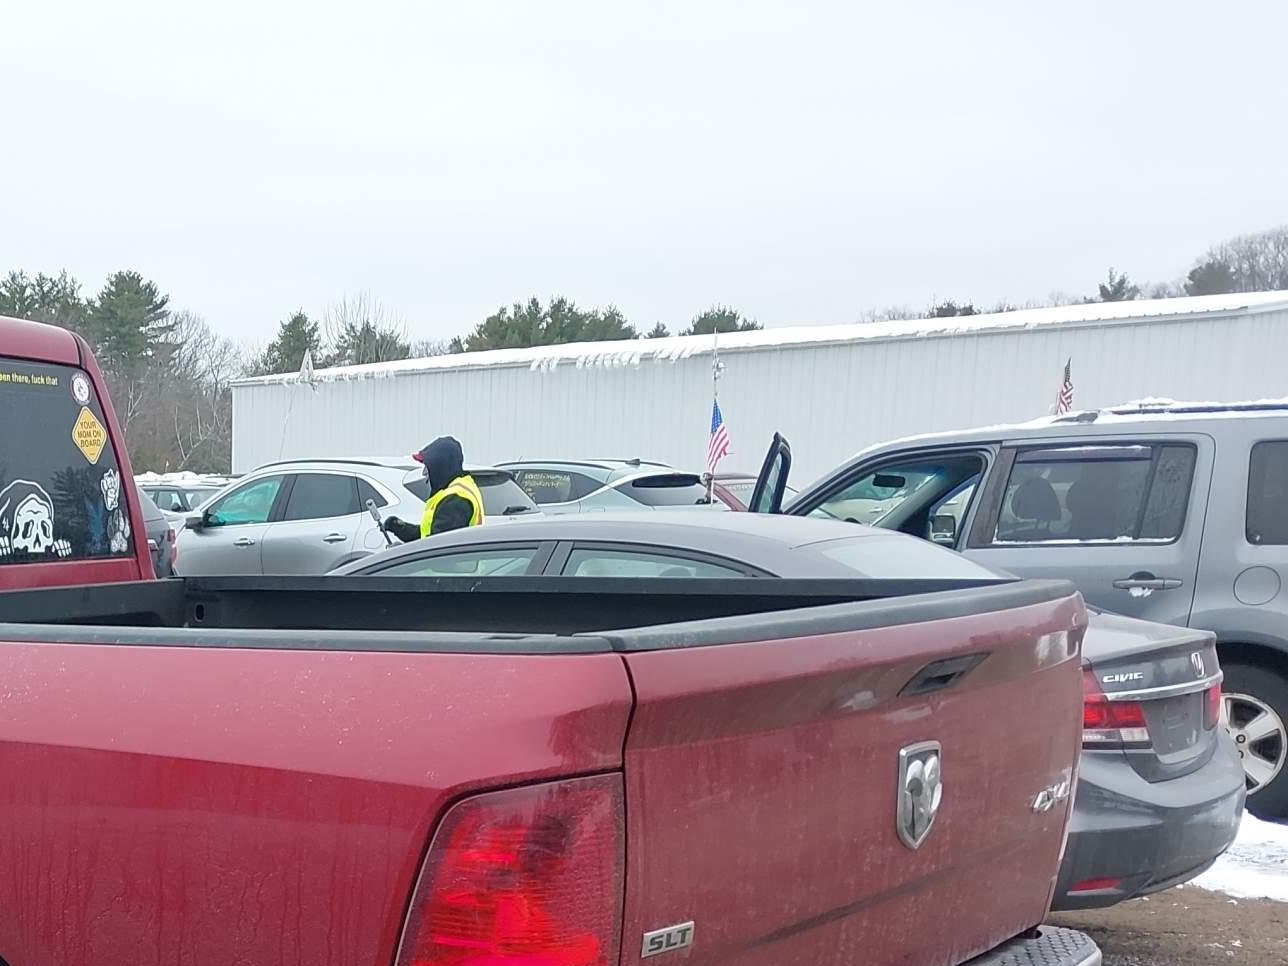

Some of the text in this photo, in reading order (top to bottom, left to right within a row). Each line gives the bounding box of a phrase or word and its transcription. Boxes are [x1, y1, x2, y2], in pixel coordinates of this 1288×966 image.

[12, 372, 31, 384] there,
[32, 373, 45, 385] fuck
[46, 375, 58, 386] that
[80, 421, 96, 429] YOUR
[80, 439, 101, 448] BOARD
[1102, 671, 1144, 683] CIVIC
[647, 927, 692, 953] SLT
